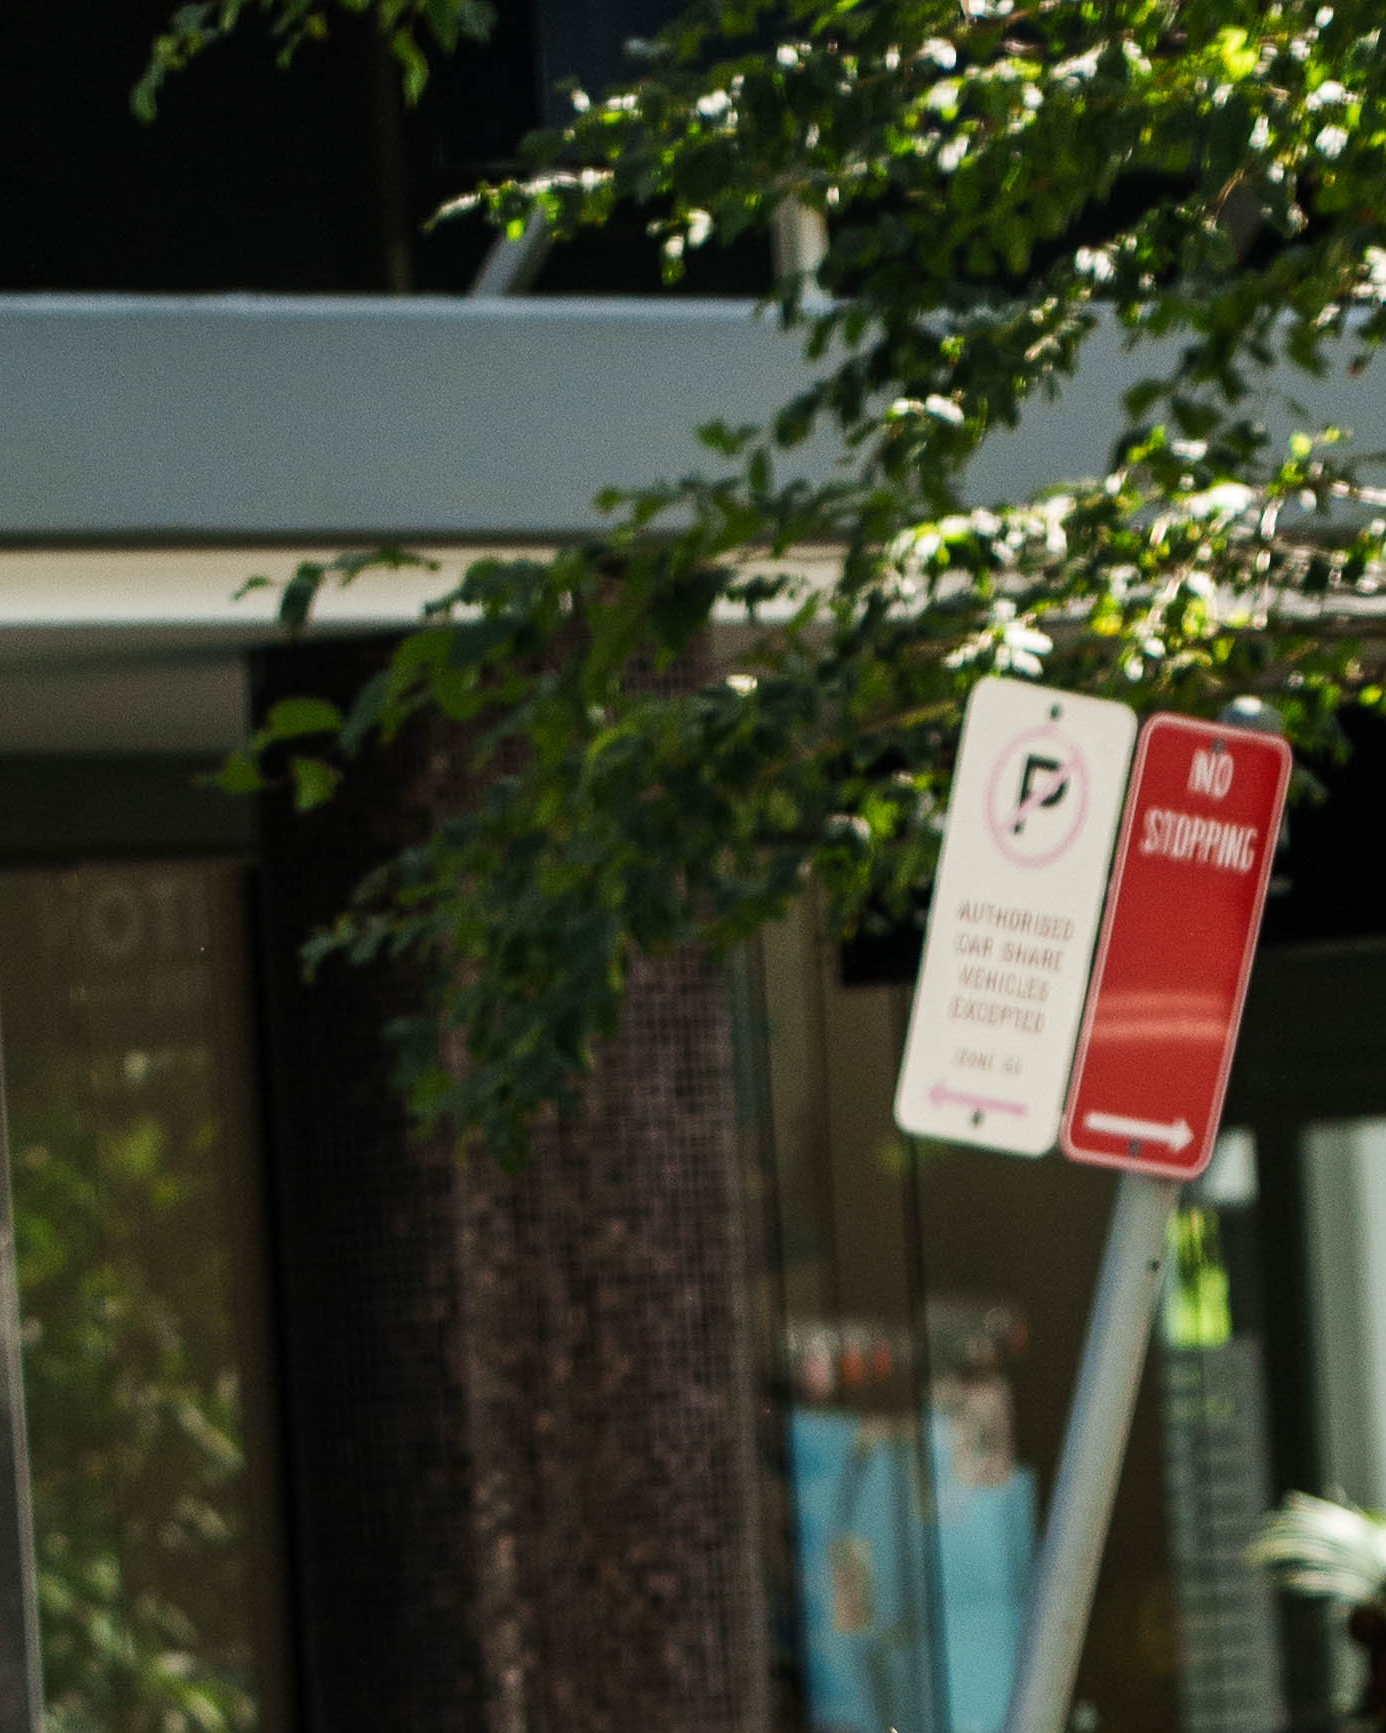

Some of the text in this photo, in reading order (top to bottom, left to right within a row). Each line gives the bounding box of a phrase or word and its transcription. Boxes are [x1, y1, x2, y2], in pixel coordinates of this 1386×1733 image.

[1187, 750, 1234, 799] NO
[1142, 808, 1258, 873] STOPPING
[957, 899, 1075, 942] AUTHORISED
[954, 933, 1063, 972] CAR SHARE
[957, 966, 1049, 1002] VEHICLES
[950, 998, 1046, 1036] EXCEPTED
